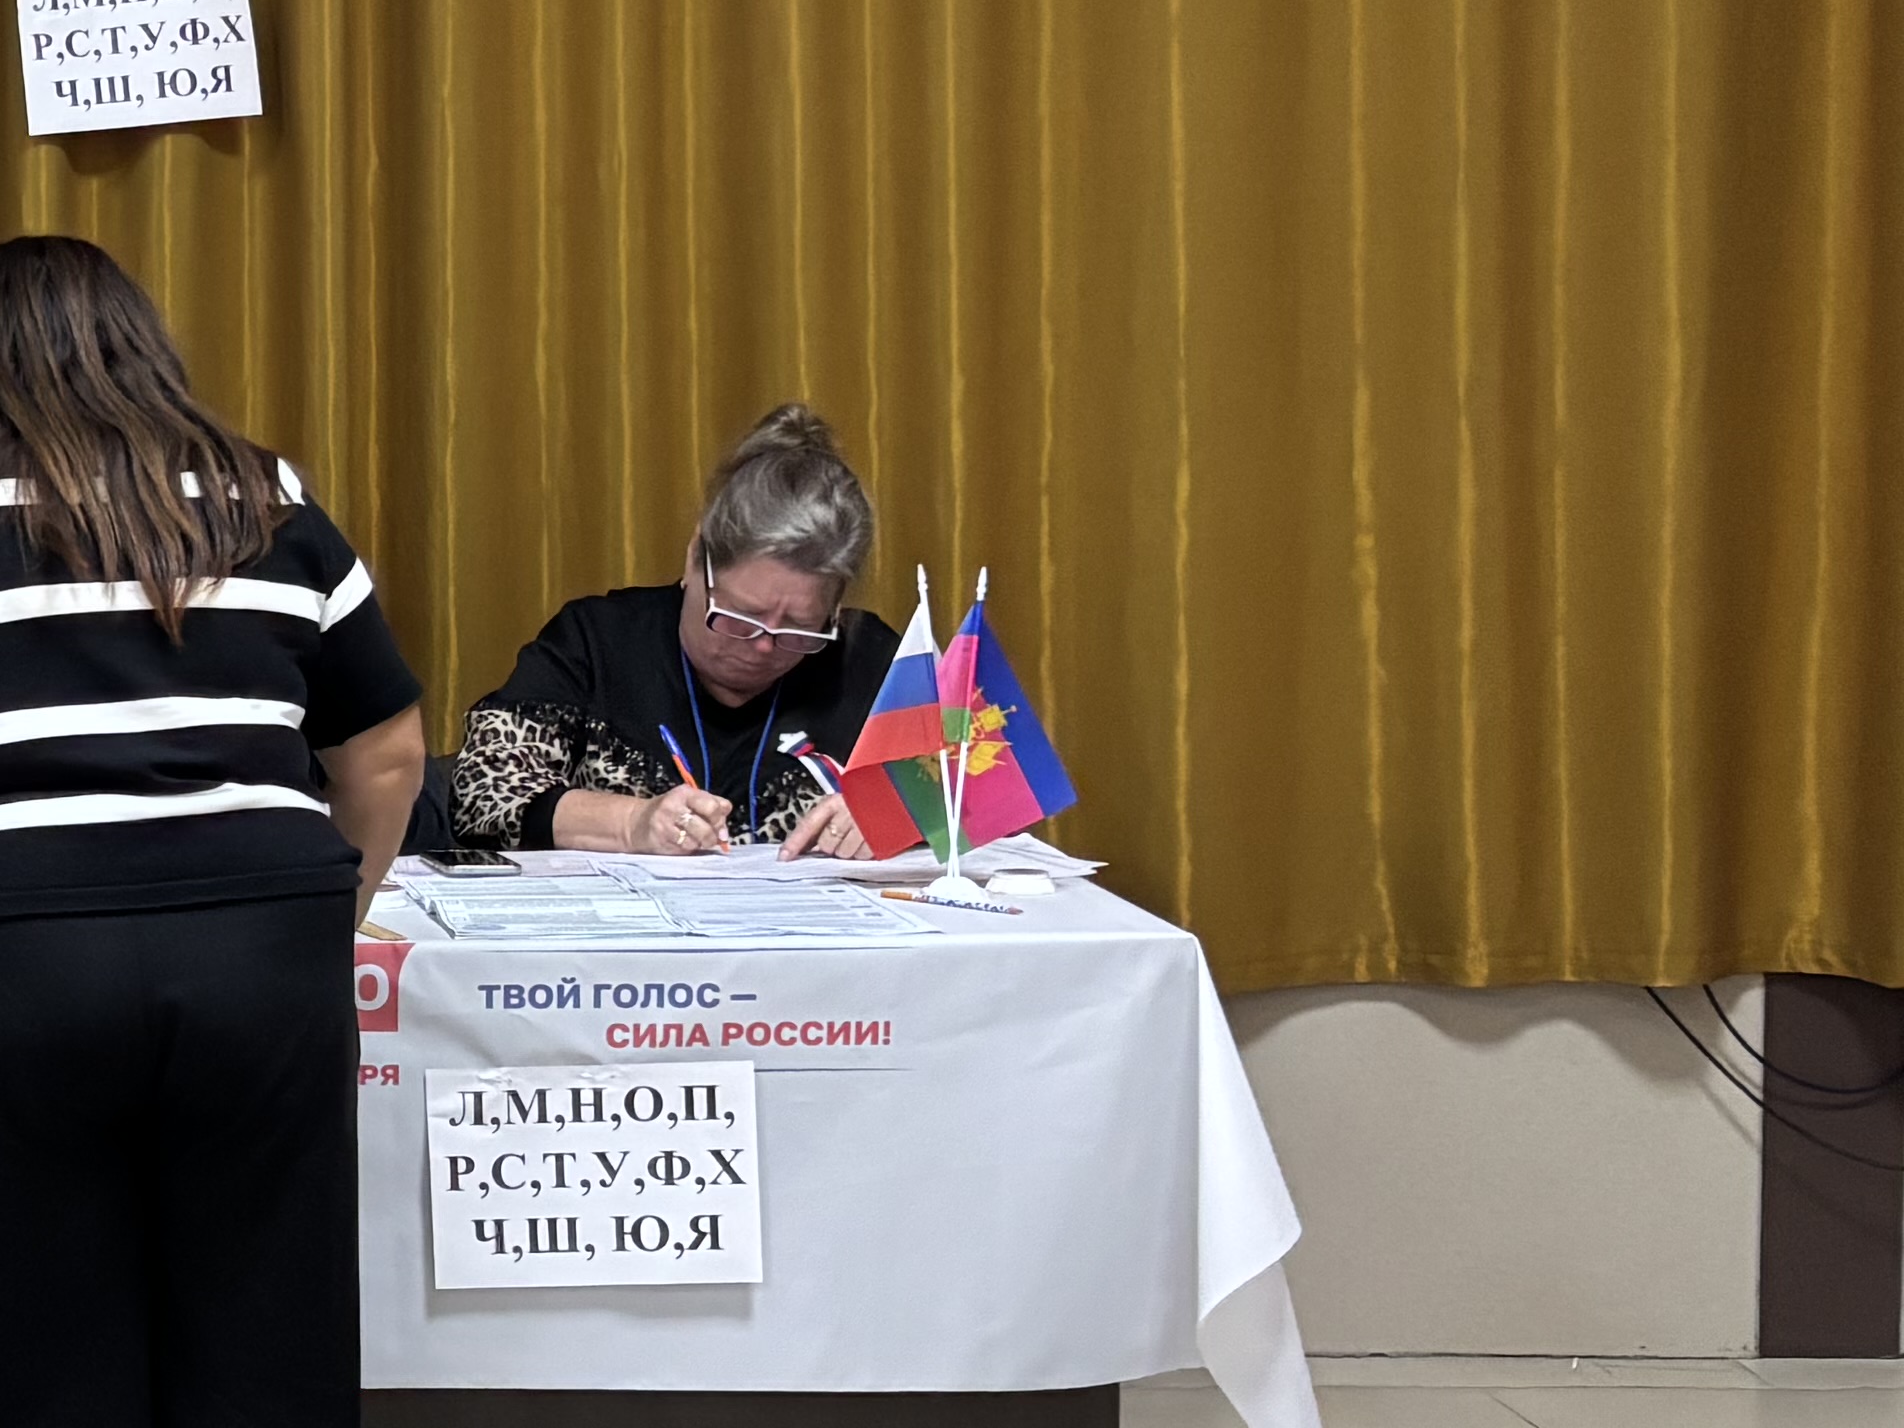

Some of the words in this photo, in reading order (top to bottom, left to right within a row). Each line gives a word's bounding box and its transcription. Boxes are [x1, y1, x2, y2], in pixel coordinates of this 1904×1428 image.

[31, 14, 245, 66] Р,С,Т,У,Ф,Х
[52, 75, 143, 111] Ч,Ш,
[156, 64, 232, 100] Ю,Я
[478, 977, 580, 1010] ТВОЙ
[592, 982, 719, 1010] ГОЛОС
[606, 1022, 709, 1048] СИЛА
[721, 1019, 890, 1047] РОССИИ!
[449, 1085, 735, 1132] Л,М,Н,О,П,
[445, 1149, 746, 1198] Р,С,Т,У,Ф,Х
[472, 1217, 595, 1261] Ч,Ш,
[611, 1215, 724, 1258] Ю,Я
